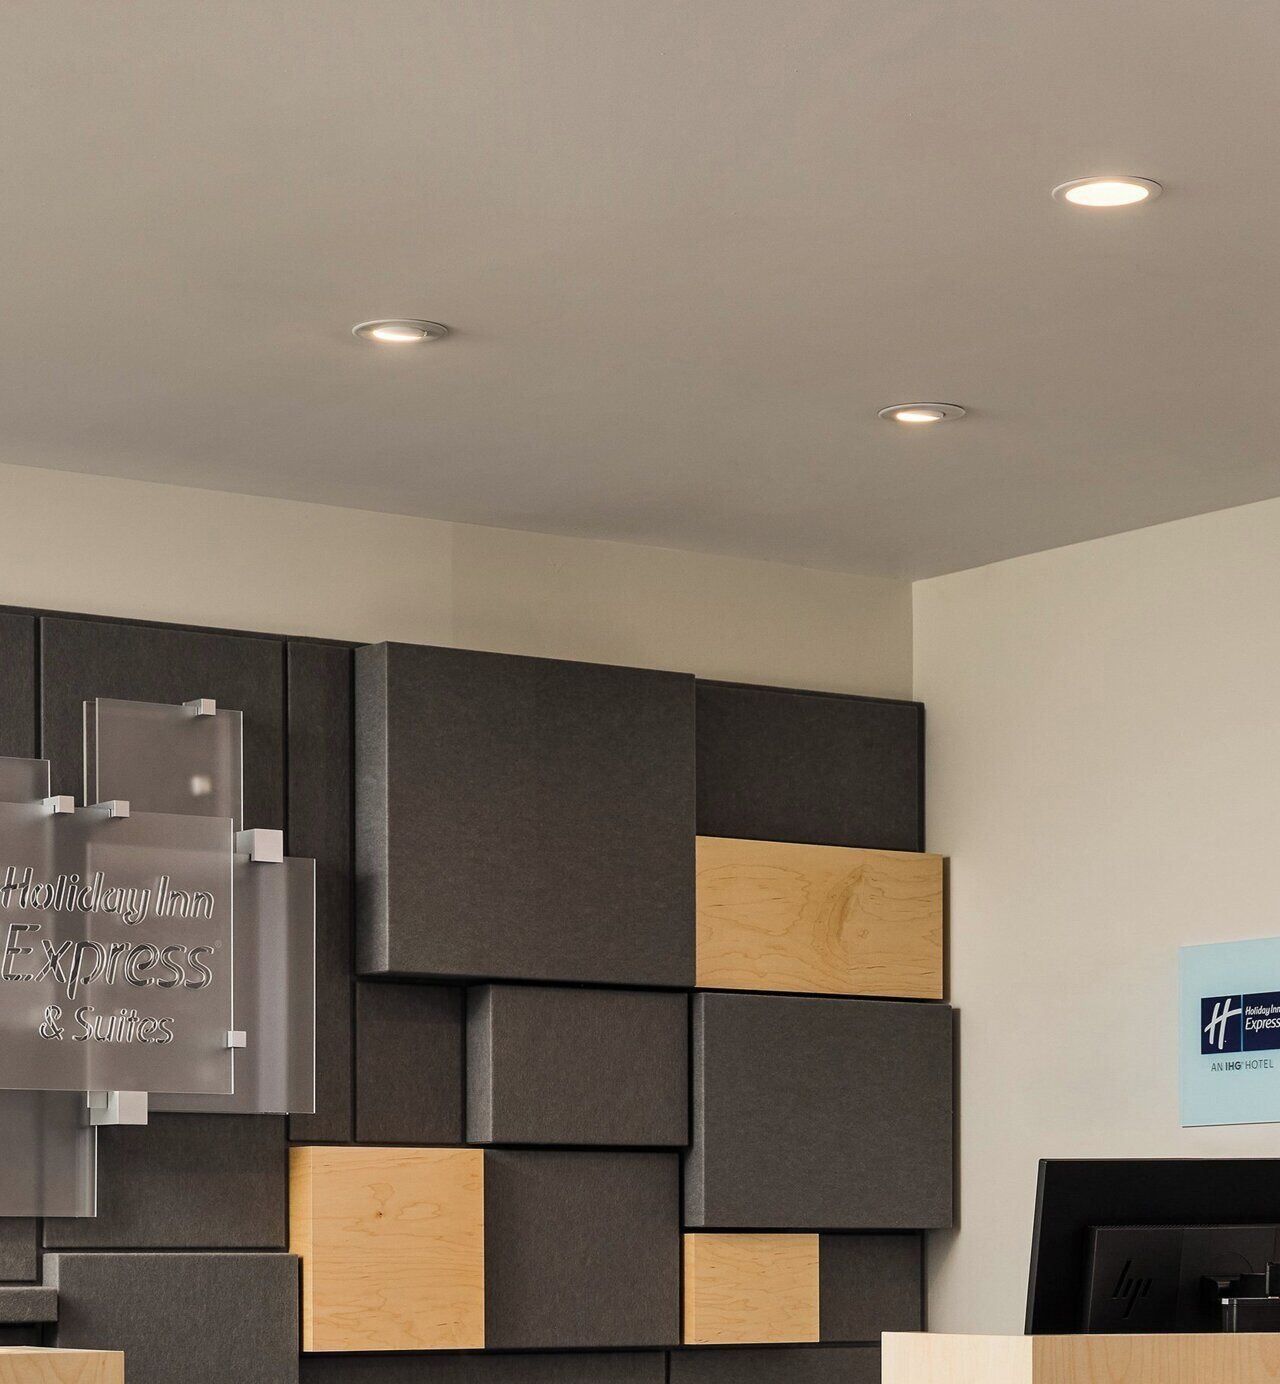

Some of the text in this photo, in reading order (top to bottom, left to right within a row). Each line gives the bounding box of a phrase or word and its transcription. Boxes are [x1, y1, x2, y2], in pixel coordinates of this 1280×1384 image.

[0, 866, 215, 925] Holiday Inn
[1, 922, 216, 1000] Express
[39, 1004, 175, 1044] & Suites
[1245, 1005, 1270, 1017] Holiday
[1211, 1059, 1274, 1072] AN IHG HOTEL
